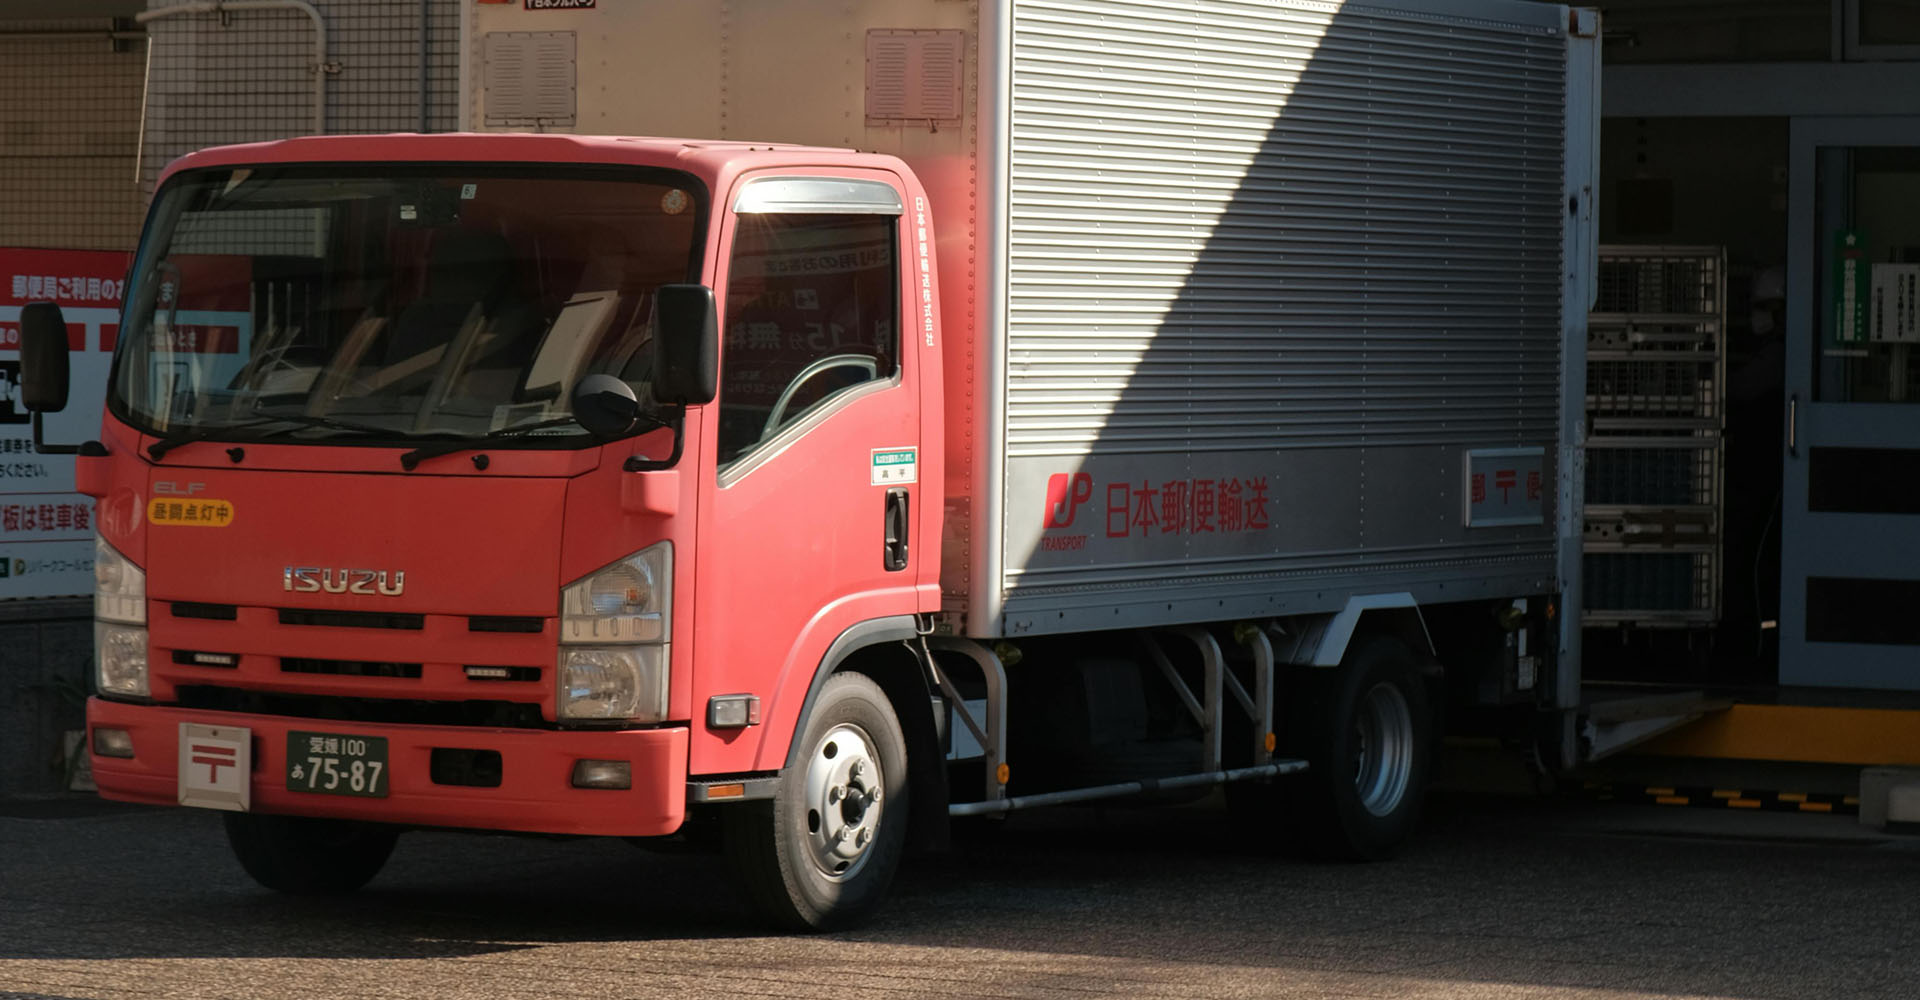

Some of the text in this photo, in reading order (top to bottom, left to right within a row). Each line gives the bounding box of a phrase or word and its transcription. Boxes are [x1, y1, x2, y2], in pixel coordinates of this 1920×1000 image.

[915, 196, 935, 347] 日本郵便輸送株式会社
[0, 438, 32, 454] 車券を
[153, 481, 206, 495] ELF
[2, 503, 96, 532] 板は駐車後
[153, 502, 229, 523] 昼間点灯中
[1106, 476, 1270, 538] 日本郵便輸送
[1041, 535, 1088, 551] TRANSPORT
[283, 566, 405, 597] ISUZU
[290, 756, 383, 793] あ 75-87
